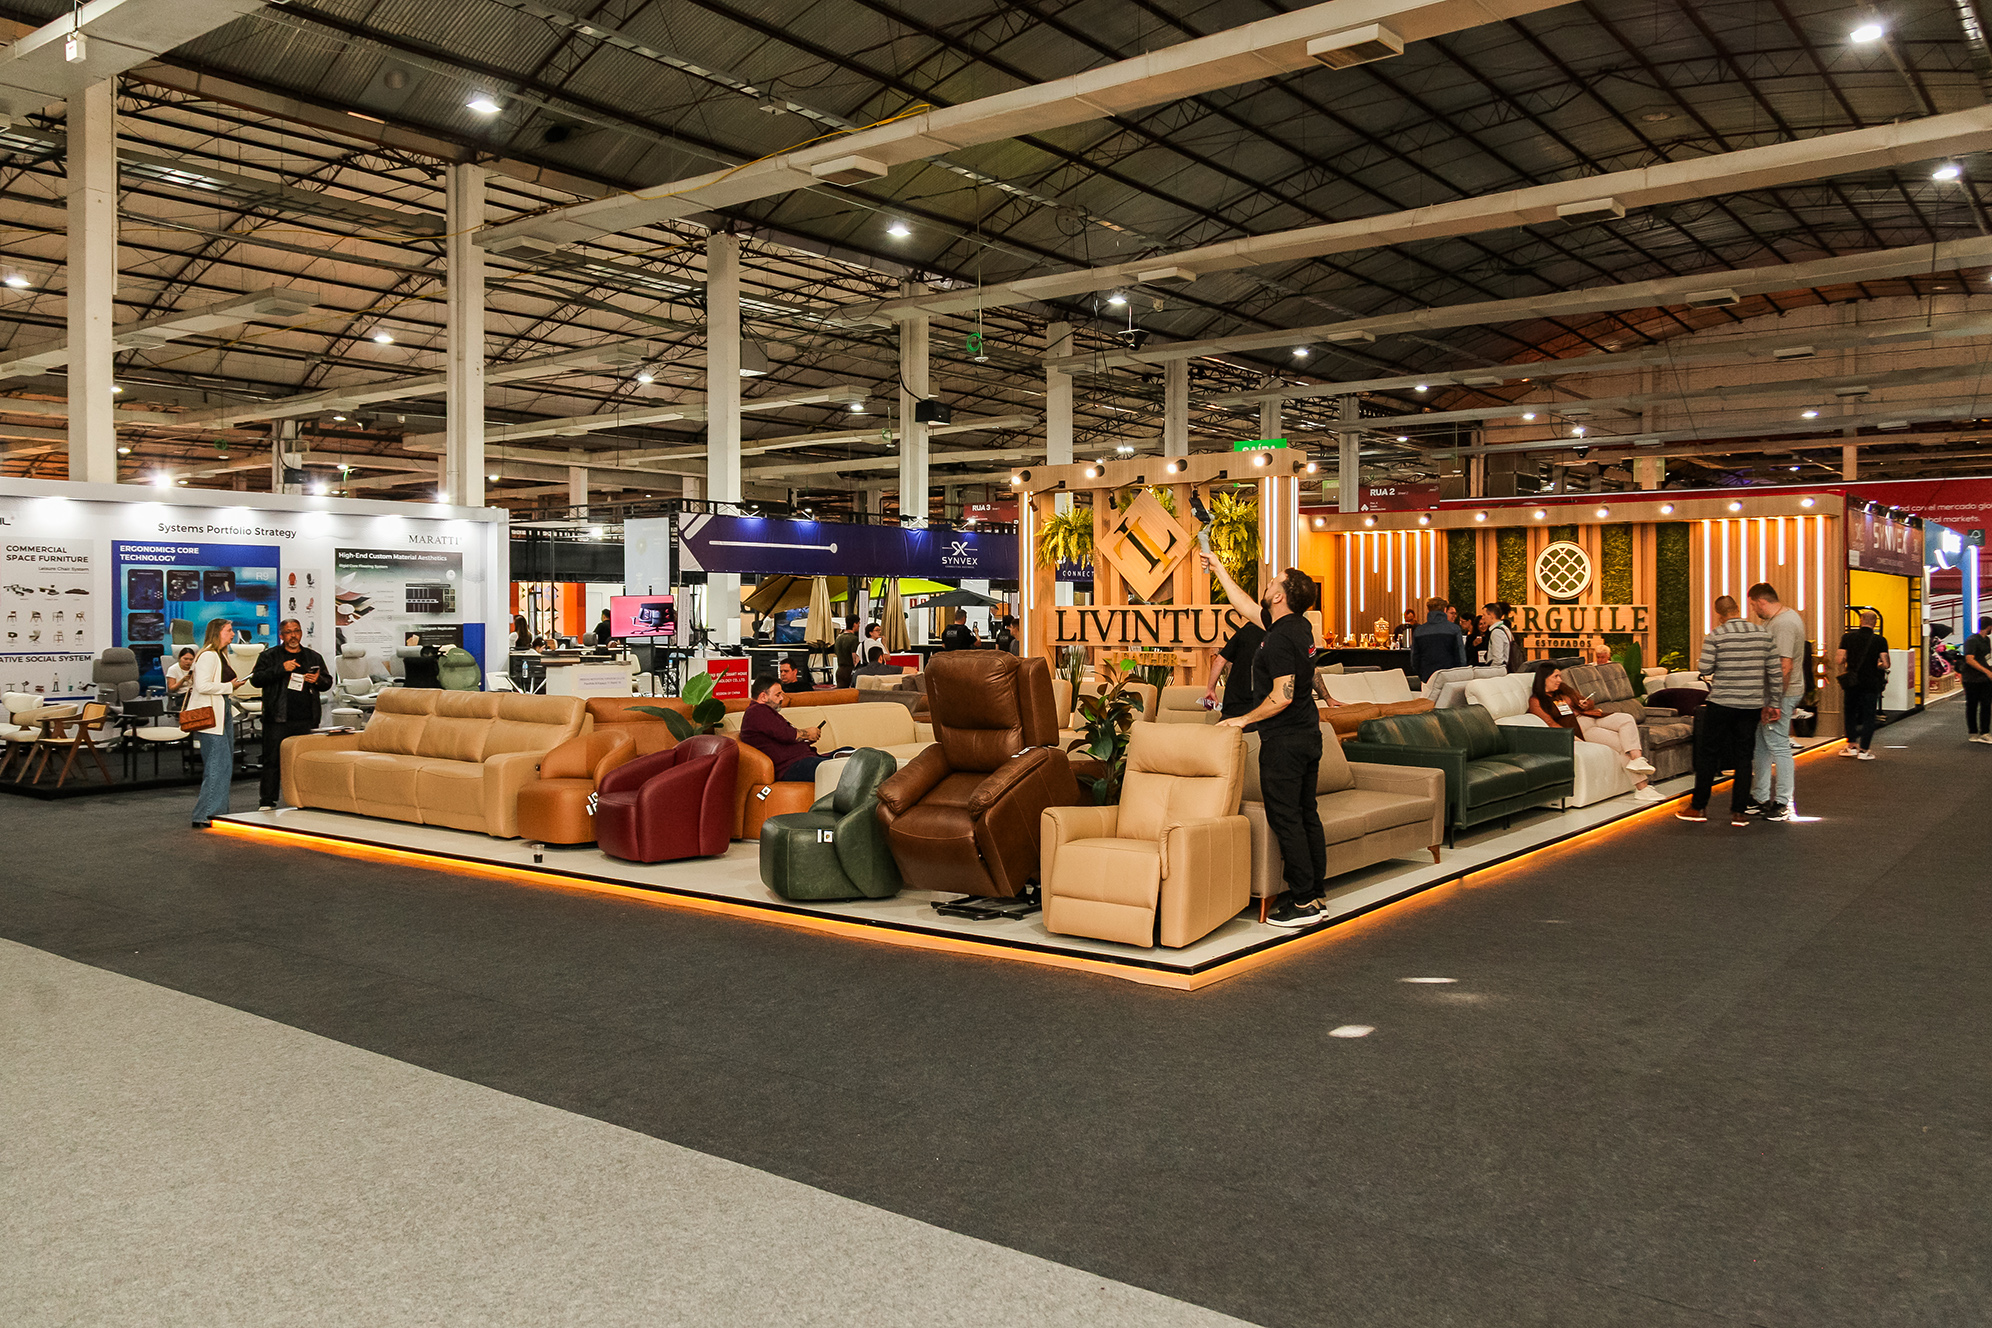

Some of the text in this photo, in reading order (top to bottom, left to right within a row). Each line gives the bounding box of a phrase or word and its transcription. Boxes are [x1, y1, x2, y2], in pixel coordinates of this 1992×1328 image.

[1389, 488, 1395, 496] 2
[158, 522, 297, 539] Systems Portfolio Strategy
[6, 545, 67, 553] COMMERCIAL
[120, 545, 200, 555] ERGONOMICS CORE
[6, 554, 89, 563] SPACE FURNITURE
[120, 554, 176, 562] TECHNOLOGY
[338, 552, 368, 560] High-End
[941, 556, 978, 566] SYNVEX
[256, 571, 269, 581] R9
[1503, 606, 1649, 633] ERGUILE
[1055, 608, 1242, 644] LIVINTUS
[1535, 639, 1592, 648] ESTOFADOS
